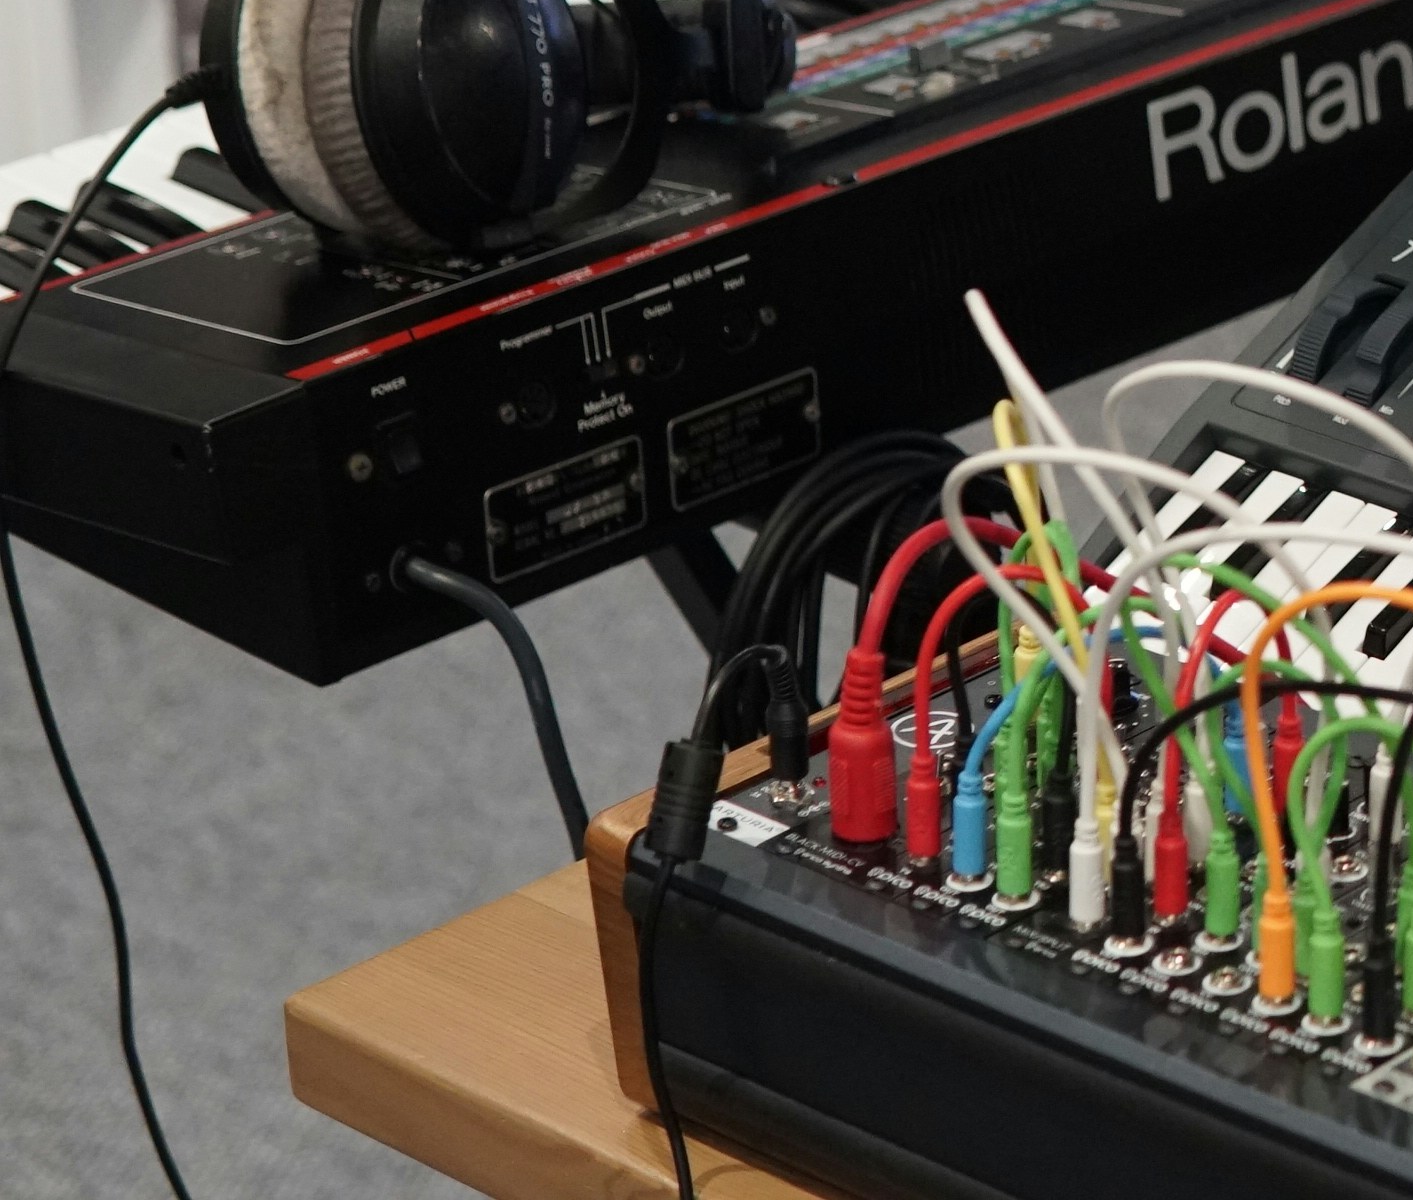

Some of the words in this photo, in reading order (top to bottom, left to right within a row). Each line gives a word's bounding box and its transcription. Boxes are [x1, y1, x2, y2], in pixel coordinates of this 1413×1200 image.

[528, 12, 547, 55] 770
[539, 62, 554, 108] PRO
[370, 375, 407, 399] POWER
